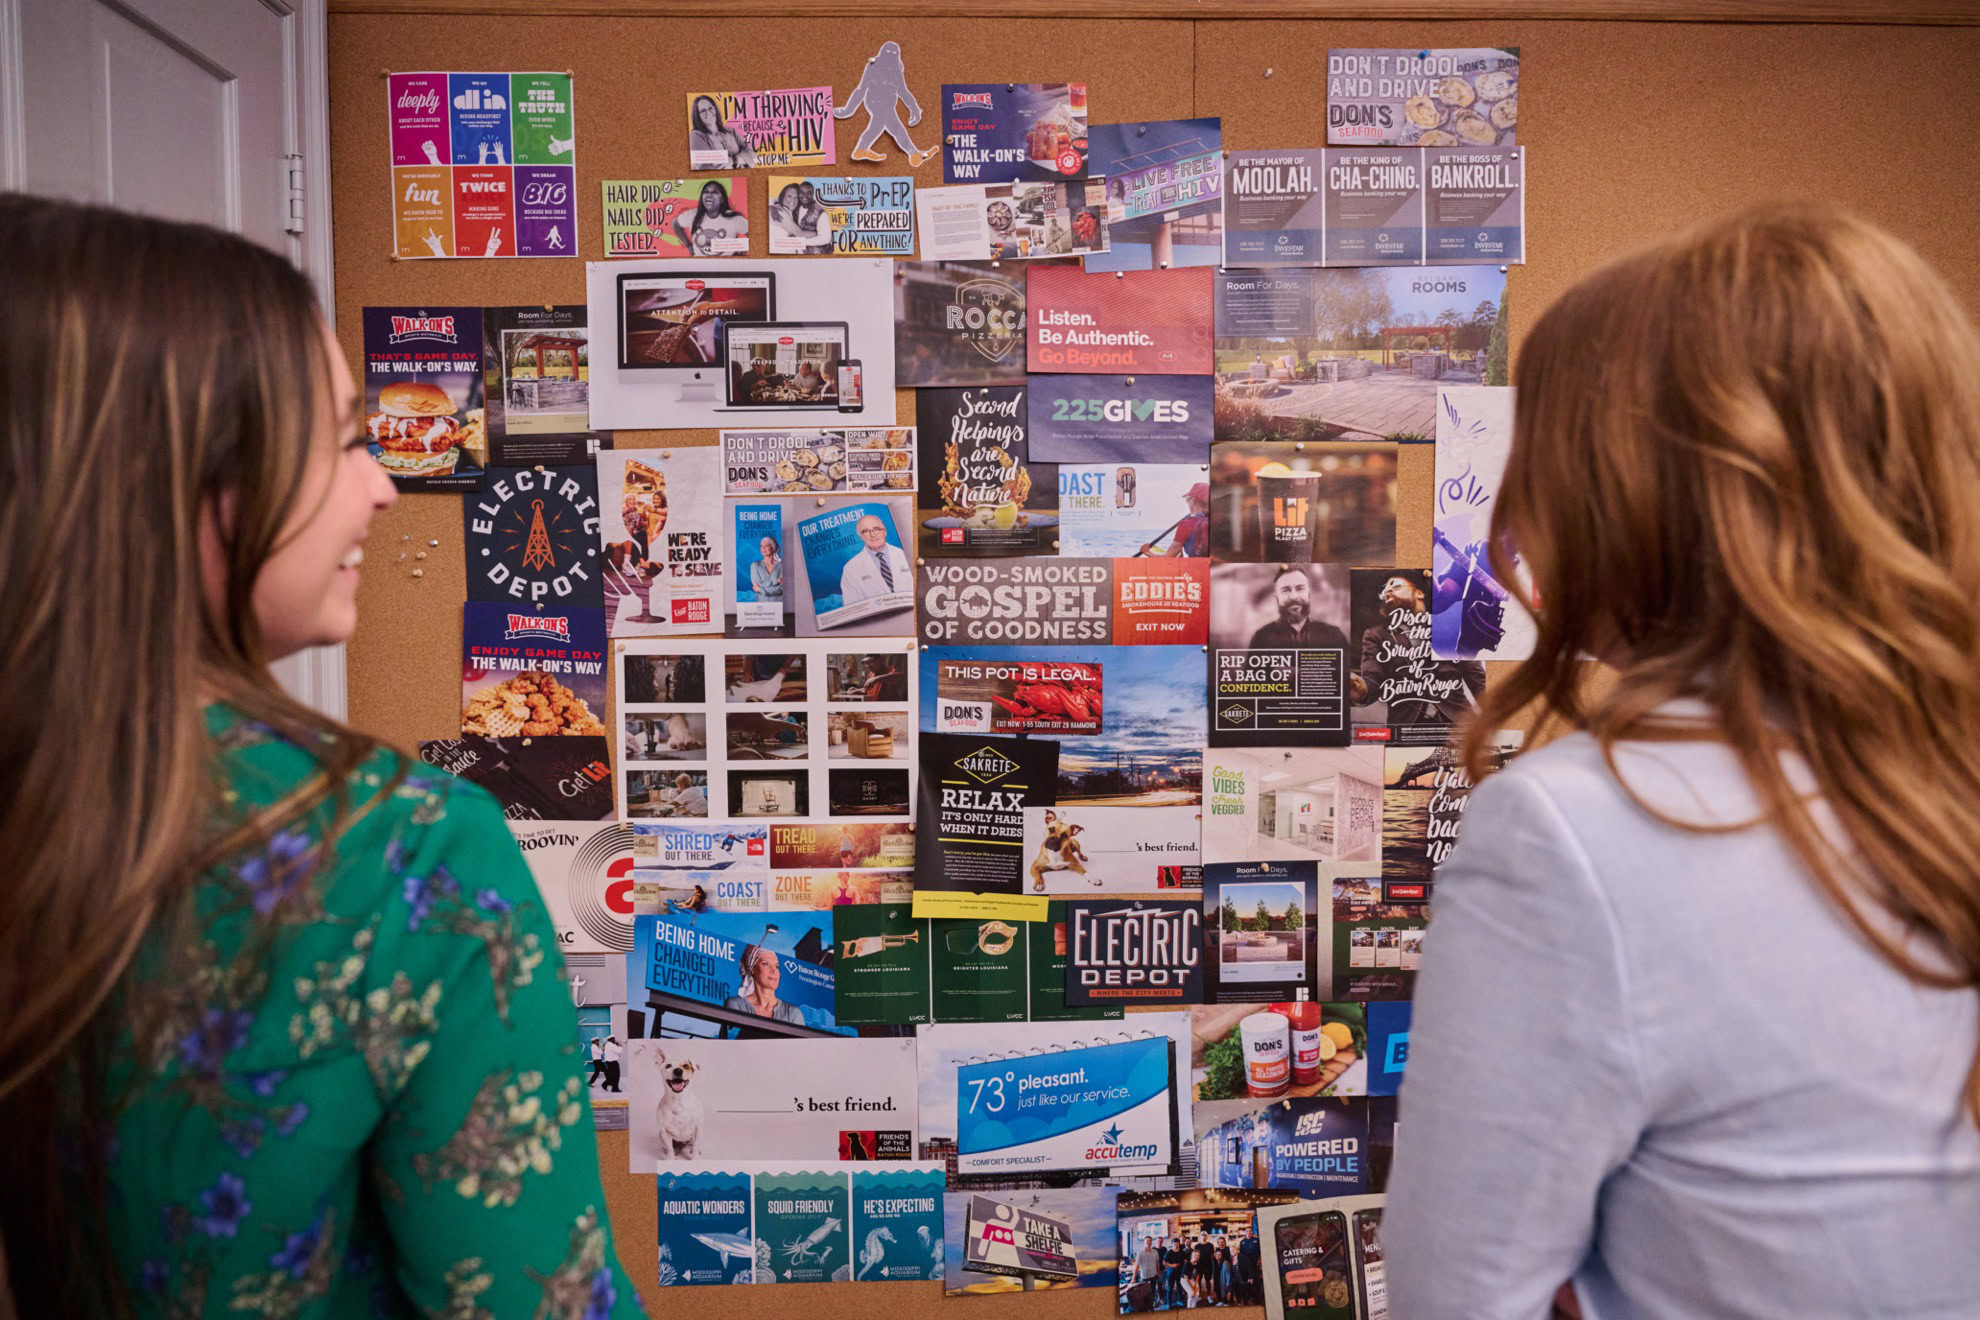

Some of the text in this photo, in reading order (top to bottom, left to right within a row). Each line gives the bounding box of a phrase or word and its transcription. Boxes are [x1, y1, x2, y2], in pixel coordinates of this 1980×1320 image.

[1330, 55, 1463, 76] DON'T DROOL
[1330, 78, 1440, 98] AND DRIVE
[398, 88, 440, 114] deeply
[1330, 104, 1393, 128] DON'S
[744, 120, 774, 132] BECAUSE
[751, 118, 824, 152] CAN'T HIV
[1338, 128, 1383, 138] SEAFOOD
[952, 134, 977, 147] THE
[953, 149, 1025, 162] WALK-ON'S
[953, 165, 981, 178] WAY
[1132, 156, 1216, 190] LIVE FREE.
[1233, 166, 1318, 194] MOOLAH.
[1330, 166, 1420, 190] CHA-CHING.
[1432, 165, 1519, 189] BANKROLL.
[405, 182, 442, 205] fun
[460, 182, 506, 193] TWICE
[522, 182, 566, 205] BIG
[607, 184, 664, 203] HAIR DID.
[822, 183, 854, 196] THANKS
[856, 183, 866, 195] TO
[608, 208, 668, 227] NAILS DID.
[831, 213, 908, 228] WE'RE PREPARED
[610, 231, 657, 250] TESTED.
[832, 230, 912, 252] FOR ANYTHING!
[1412, 282, 1466, 293] ROOMS
[947, 305, 1027, 329] ROCCA
[1039, 309, 1096, 326] Listen.
[1039, 329, 1154, 346] Be Authentic.
[1039, 349, 1137, 367] Go Beyond.
[958, 391, 1023, 418] Second
[952, 415, 1024, 449] Helpings
[728, 437, 810, 449] DON'T DROOL
[728, 451, 796, 463] AND DRIVE
[971, 450, 1000, 463] are
[728, 467, 768, 482] DON'S
[955, 456, 1018, 483] Second
[1059, 473, 1105, 495] OAST
[472, 470, 600, 534] ELECTRIC
[802, 509, 865, 536] OUR TREATMENT
[668, 533, 706, 547] WE'RE
[804, 528, 841, 547] CHANGES
[668, 547, 712, 562] READY
[488, 562, 589, 601] DEPOT
[926, 566, 1106, 583] WOOD-SMOKED
[1121, 582, 1202, 601] EDDIE'S
[925, 585, 1106, 618] GOSPEL
[926, 621, 1106, 640] OF GOODNESS
[1136, 623, 1185, 631] EXIT NOW
[471, 657, 602, 675] THE WALK-ON'S WAY
[1221, 655, 1291, 668] RIP OPEN
[945, 667, 1096, 681] THIS POT IS LEGAL.
[1221, 670, 1291, 682] A BAG OF
[1220, 683, 1292, 693] CONFIDENCE.
[1379, 673, 1462, 704] Baton Rouge
[944, 705, 983, 720] DON'S
[964, 758, 1011, 772] SAKRETE
[558, 771, 593, 797] Get
[1212, 778, 1245, 795] VIBES
[941, 788, 1024, 812] RELAX
[1212, 804, 1245, 815] VEGGIES
[518, 834, 579, 850] ROOVIN'
[666, 834, 712, 850] SHRED
[774, 828, 816, 844] TREAD
[718, 882, 762, 898] COAST
[776, 876, 812, 892] ZONE
[656, 920, 735, 962] BEING HOME
[1074, 909, 1198, 966] ELECTRIC
[654, 942, 714, 976] CHANGED
[653, 965, 730, 1001] EVERYTHING
[1082, 970, 1191, 985] DEPOT
[1254, 1040, 1282, 1052] DON'S
[968, 1068, 1088, 1114] 73° pleasant.
[1017, 1086, 1130, 1111] just like our service.
[809, 1098, 839, 1112] best
[844, 1096, 896, 1112] friend.
[1085, 1142, 1157, 1162] accutemp
[1276, 1138, 1358, 1157] POWERED
[1276, 1157, 1358, 1172] BY PEOPLE
[664, 1201, 745, 1214] AQUATIC WONDERS
[768, 1200, 834, 1214] SQUID FRIENDLY
[864, 1199, 934, 1214] HE'S EXPECTING
[1024, 1217, 1060, 1239] TAKE A
[1025, 1235, 1063, 1255] SHELFIE
